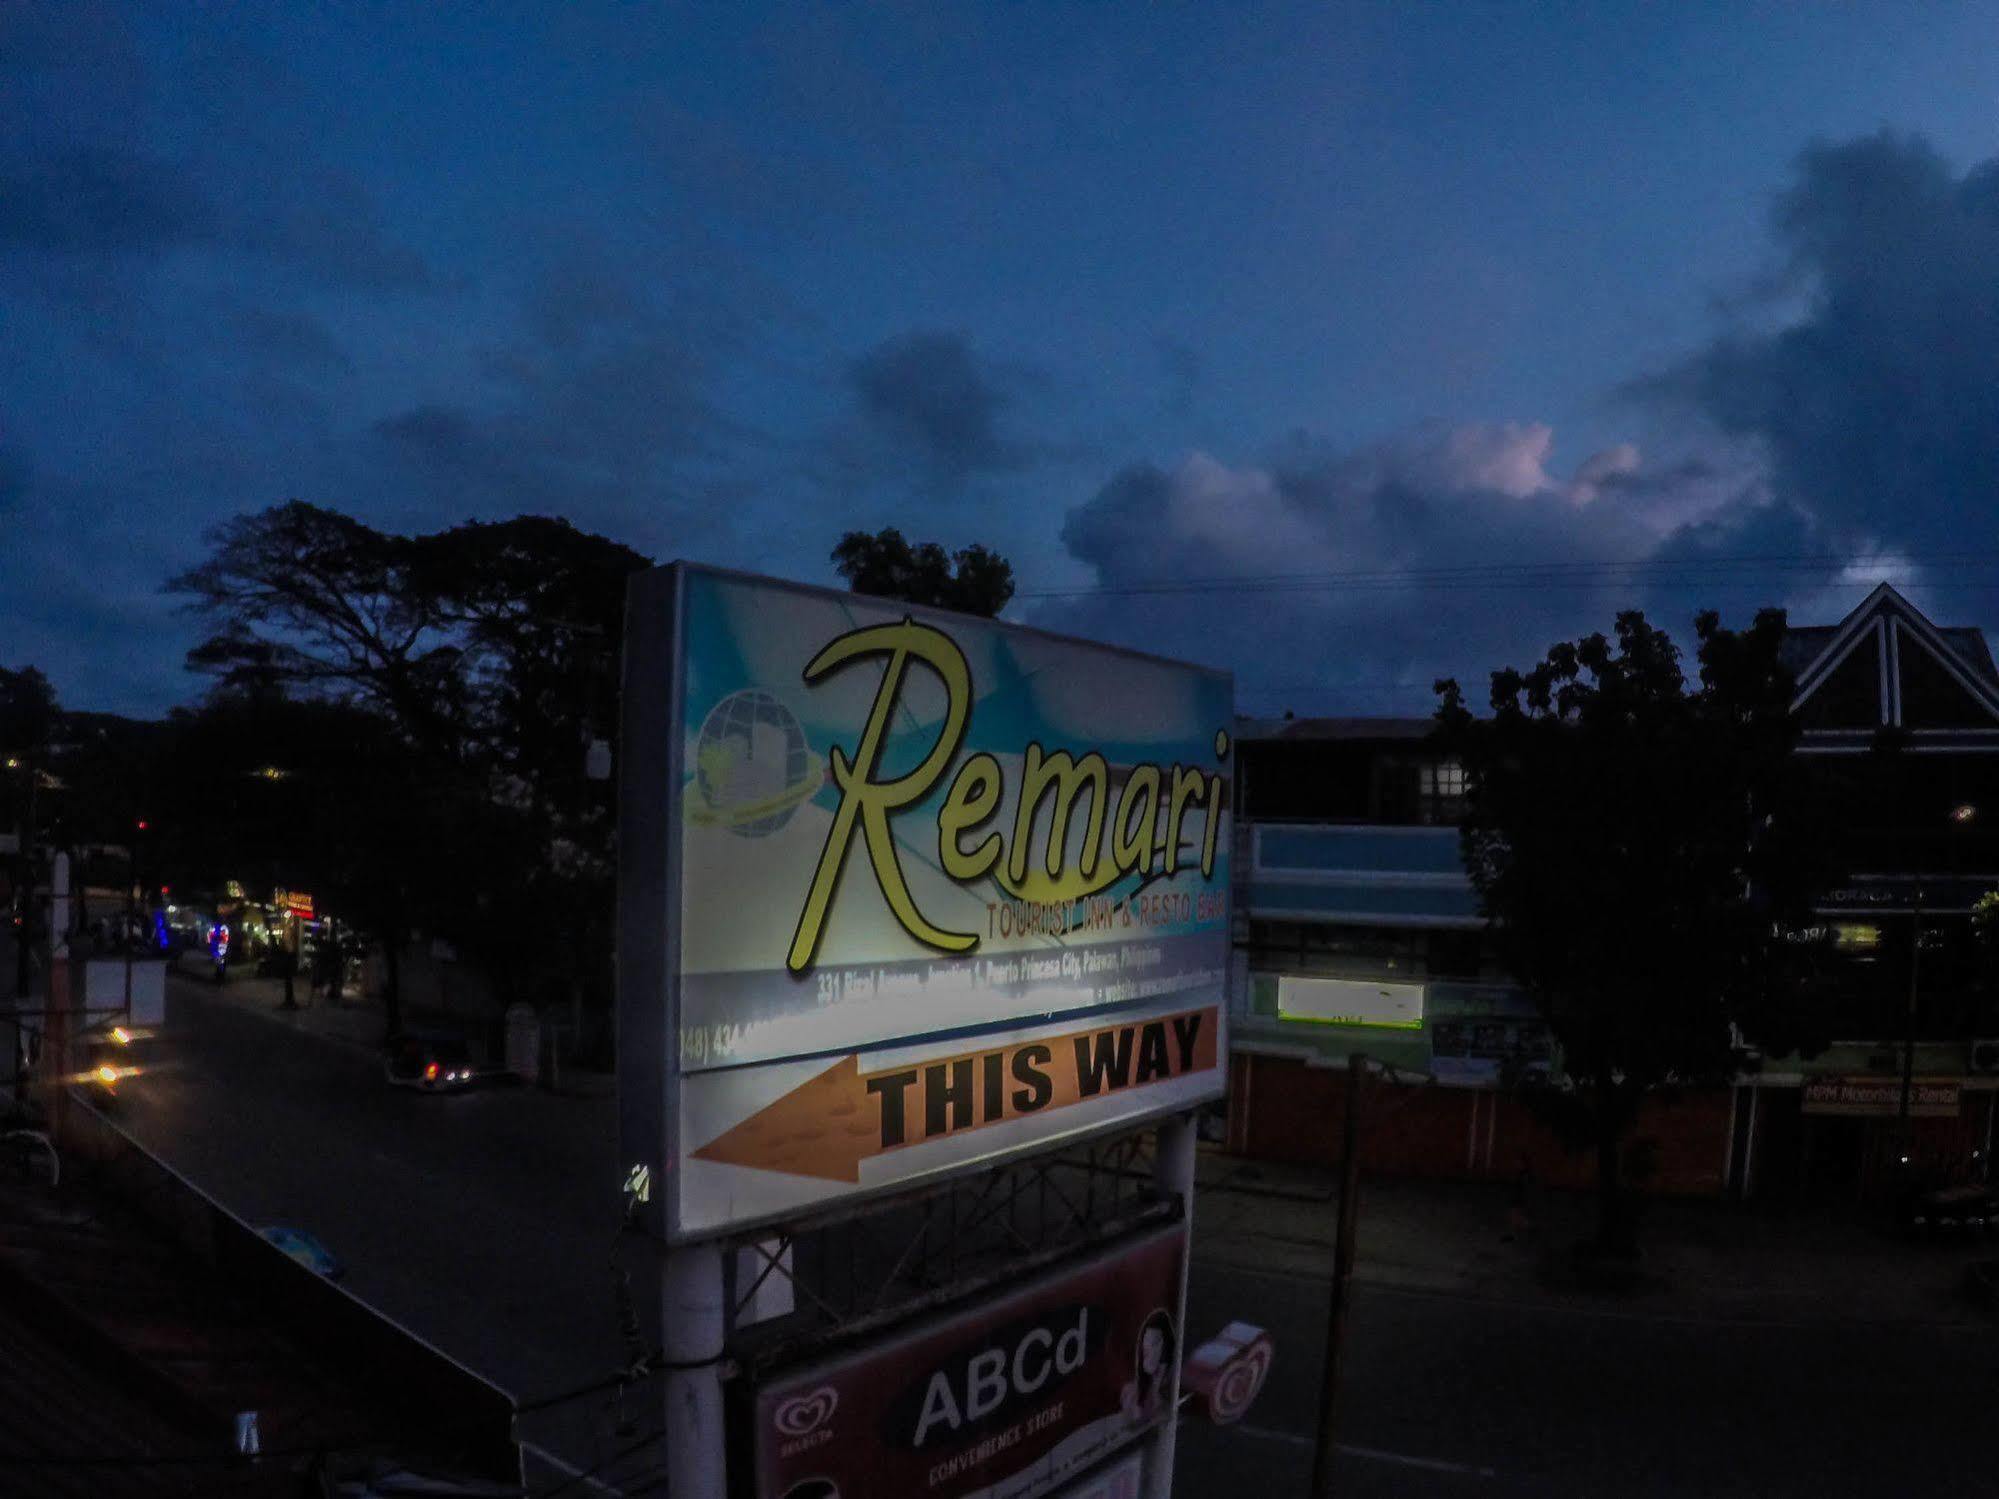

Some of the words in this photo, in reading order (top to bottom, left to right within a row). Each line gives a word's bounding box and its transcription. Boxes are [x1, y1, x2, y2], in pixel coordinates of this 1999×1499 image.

[787, 615, 1231, 975] Remari
[986, 899, 1077, 941] TOURIST
[1083, 896, 1114, 932] INN
[1121, 896, 1133, 928] &
[1139, 892, 1191, 928] RESTO
[866, 1044, 1053, 1148] THIS
[1073, 1014, 1202, 1098] WAY
[912, 1304, 1090, 1448] ABCd
[928, 1417, 1022, 1488] CONVENIENCE
[1025, 1401, 1064, 1438] STORE
